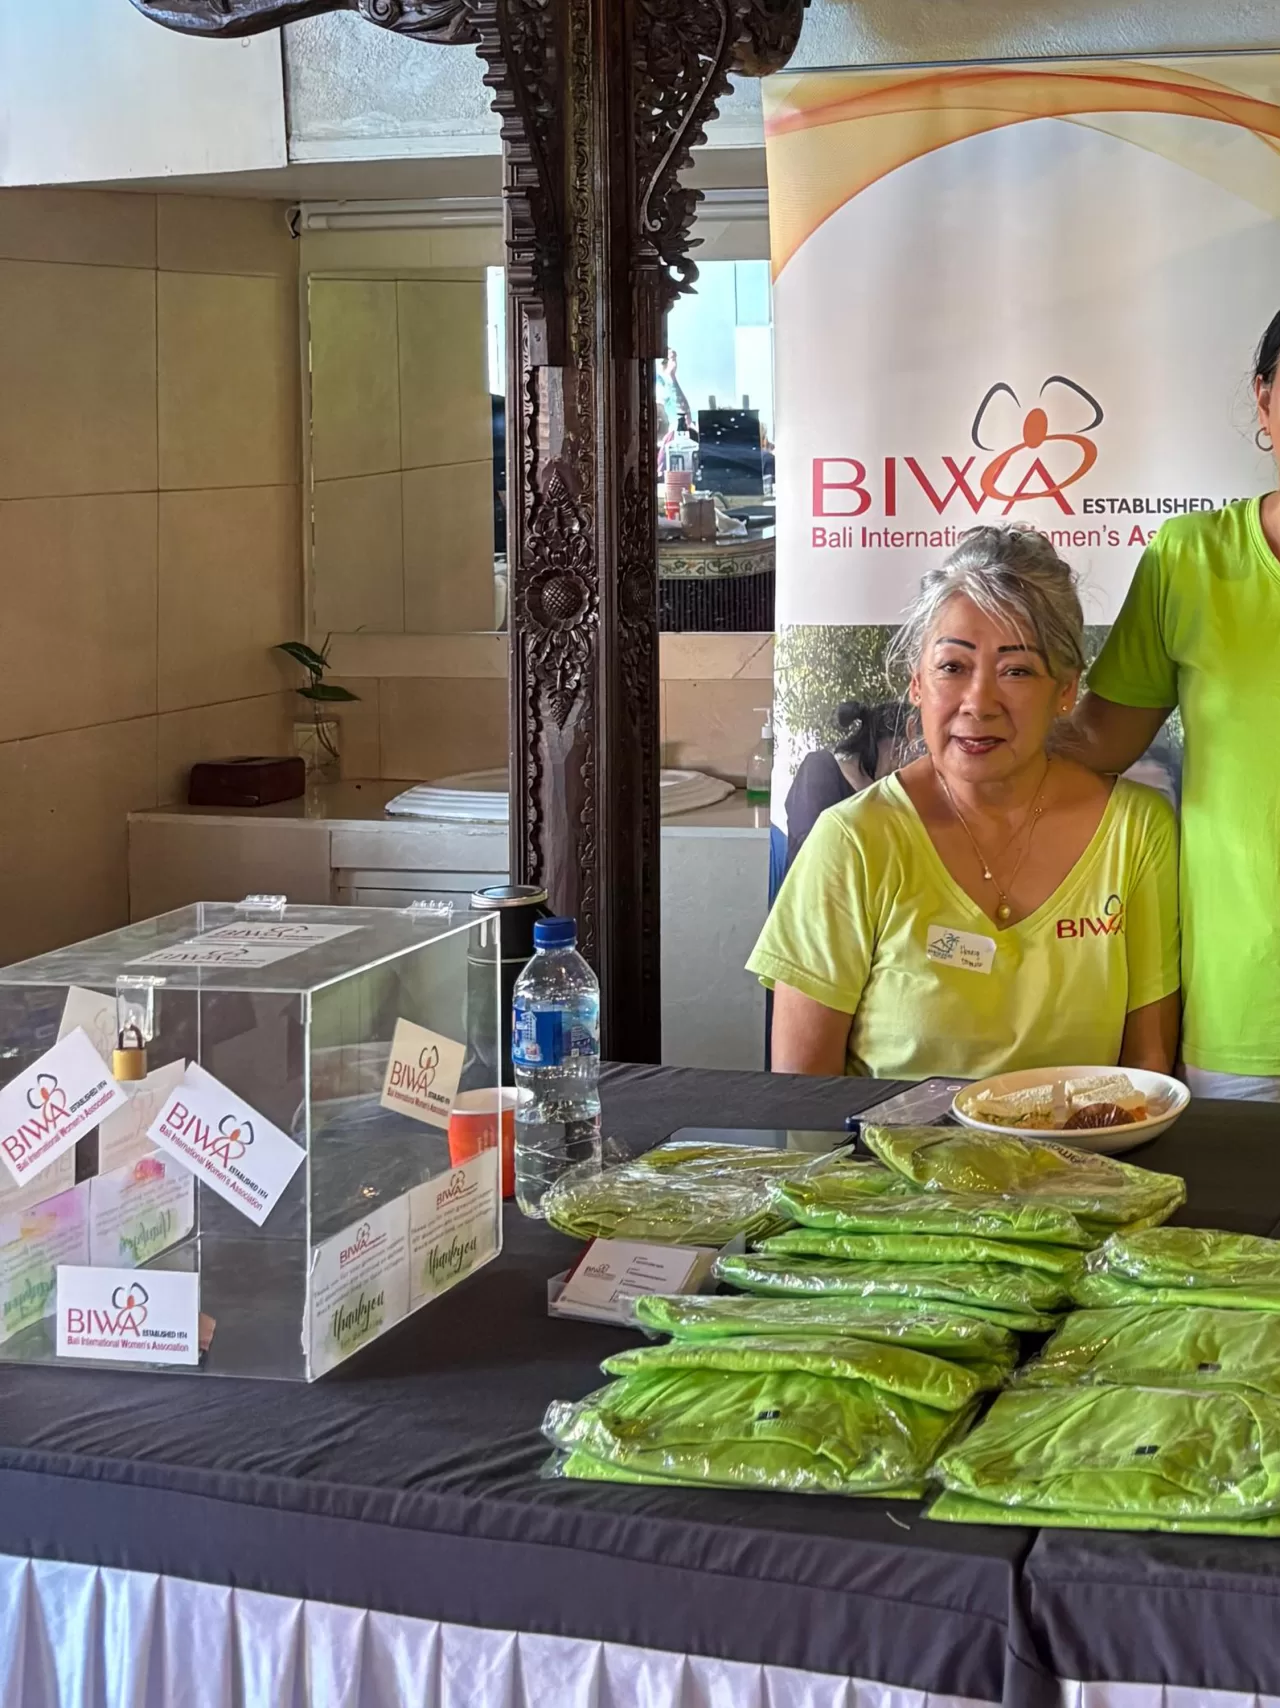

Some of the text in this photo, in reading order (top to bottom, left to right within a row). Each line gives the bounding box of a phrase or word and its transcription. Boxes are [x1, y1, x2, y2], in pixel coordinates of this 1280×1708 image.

[812, 456, 1076, 517] BIWA
[1083, 498, 1214, 515] ESTABLISHED
[812, 526, 853, 549] Bali
[1056, 917, 1124, 939] BIWA
[390, 1060, 428, 1098] BIWA
[2, 1101, 72, 1163] BIWA
[16, 1089, 116, 1172] Bali International Women's Association
[166, 1101, 231, 1168] BIWA
[159, 1123, 263, 1211] Bali International Women's Association
[228, 1165, 259, 1192] ESTABLISHED
[436, 1182, 461, 1205] BIWA
[340, 1237, 366, 1264] BIWA
[67, 1308, 140, 1337] BIWA
[142, 1329, 176, 1339] ESTABLISHED
[67, 1336, 189, 1352] Bali International Women's Association
